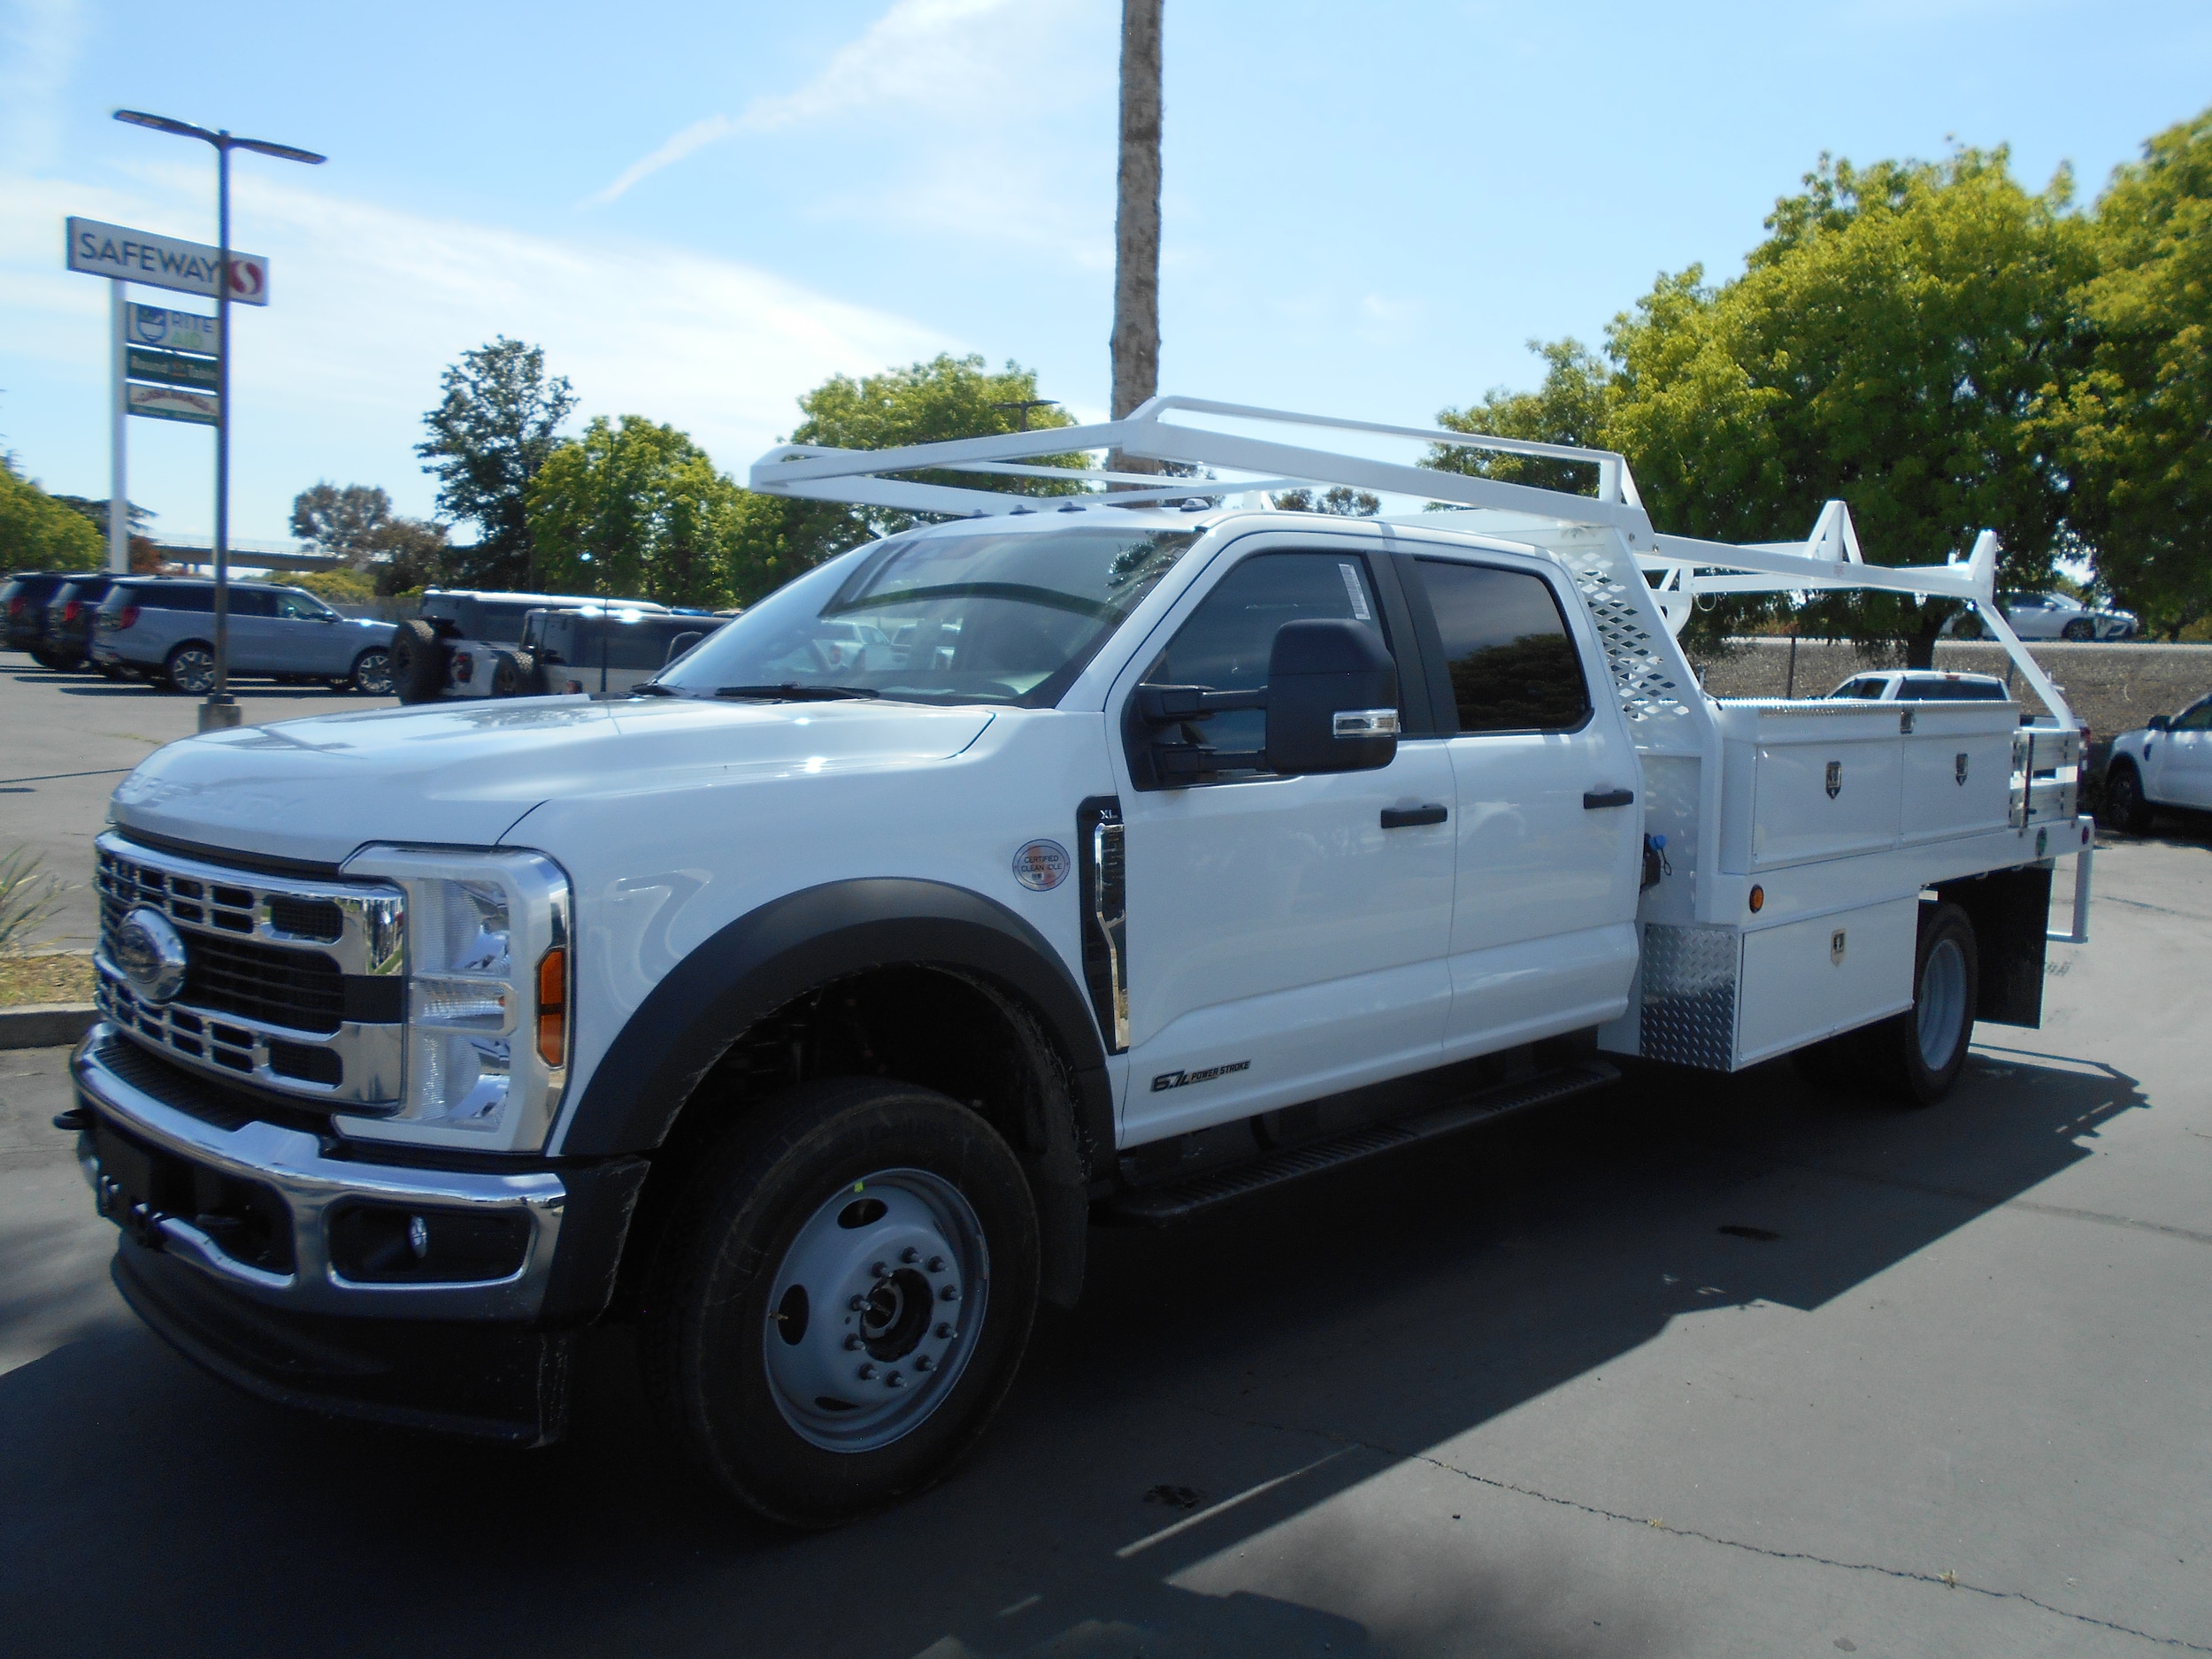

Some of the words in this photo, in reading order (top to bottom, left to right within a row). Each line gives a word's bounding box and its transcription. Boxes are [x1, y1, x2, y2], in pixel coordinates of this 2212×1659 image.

[80, 233, 220, 283] SAFEWAY
[171, 311, 213, 334] RITE
[1100, 809, 1118, 819] XL
[1024, 855, 1059, 864] CERTIFIED
[1021, 864, 1044, 872] CLEAN
[1191, 1067, 1220, 1080] POWER
[1220, 1060, 1251, 1075] STROKE
